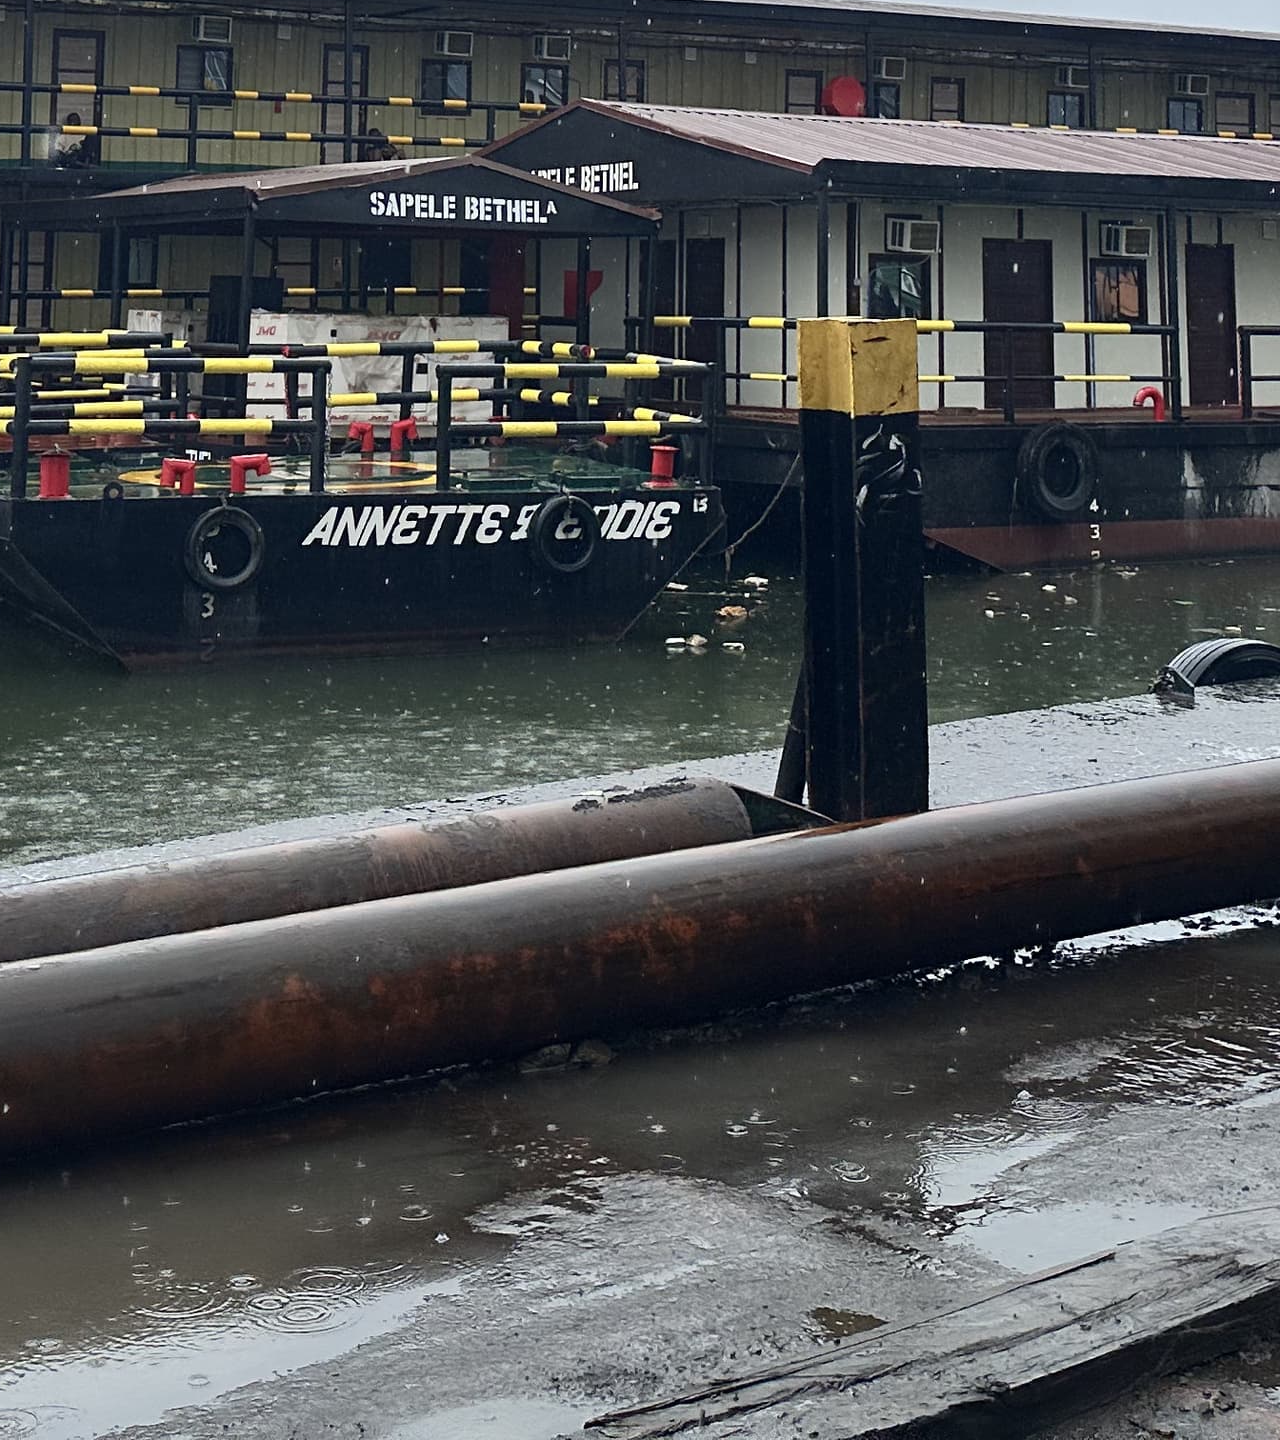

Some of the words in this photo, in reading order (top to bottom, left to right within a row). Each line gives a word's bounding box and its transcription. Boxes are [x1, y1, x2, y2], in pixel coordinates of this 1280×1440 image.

[581, 161, 639, 192] BETHEL
[370, 191, 457, 220] SAPELE
[465, 196, 548, 224] BETHEL
[1089, 498, 1099, 512] 4
[302, 504, 509, 546] ANNETTE
[1090, 524, 1100, 539] 3
[201, 592, 215, 619] 3
